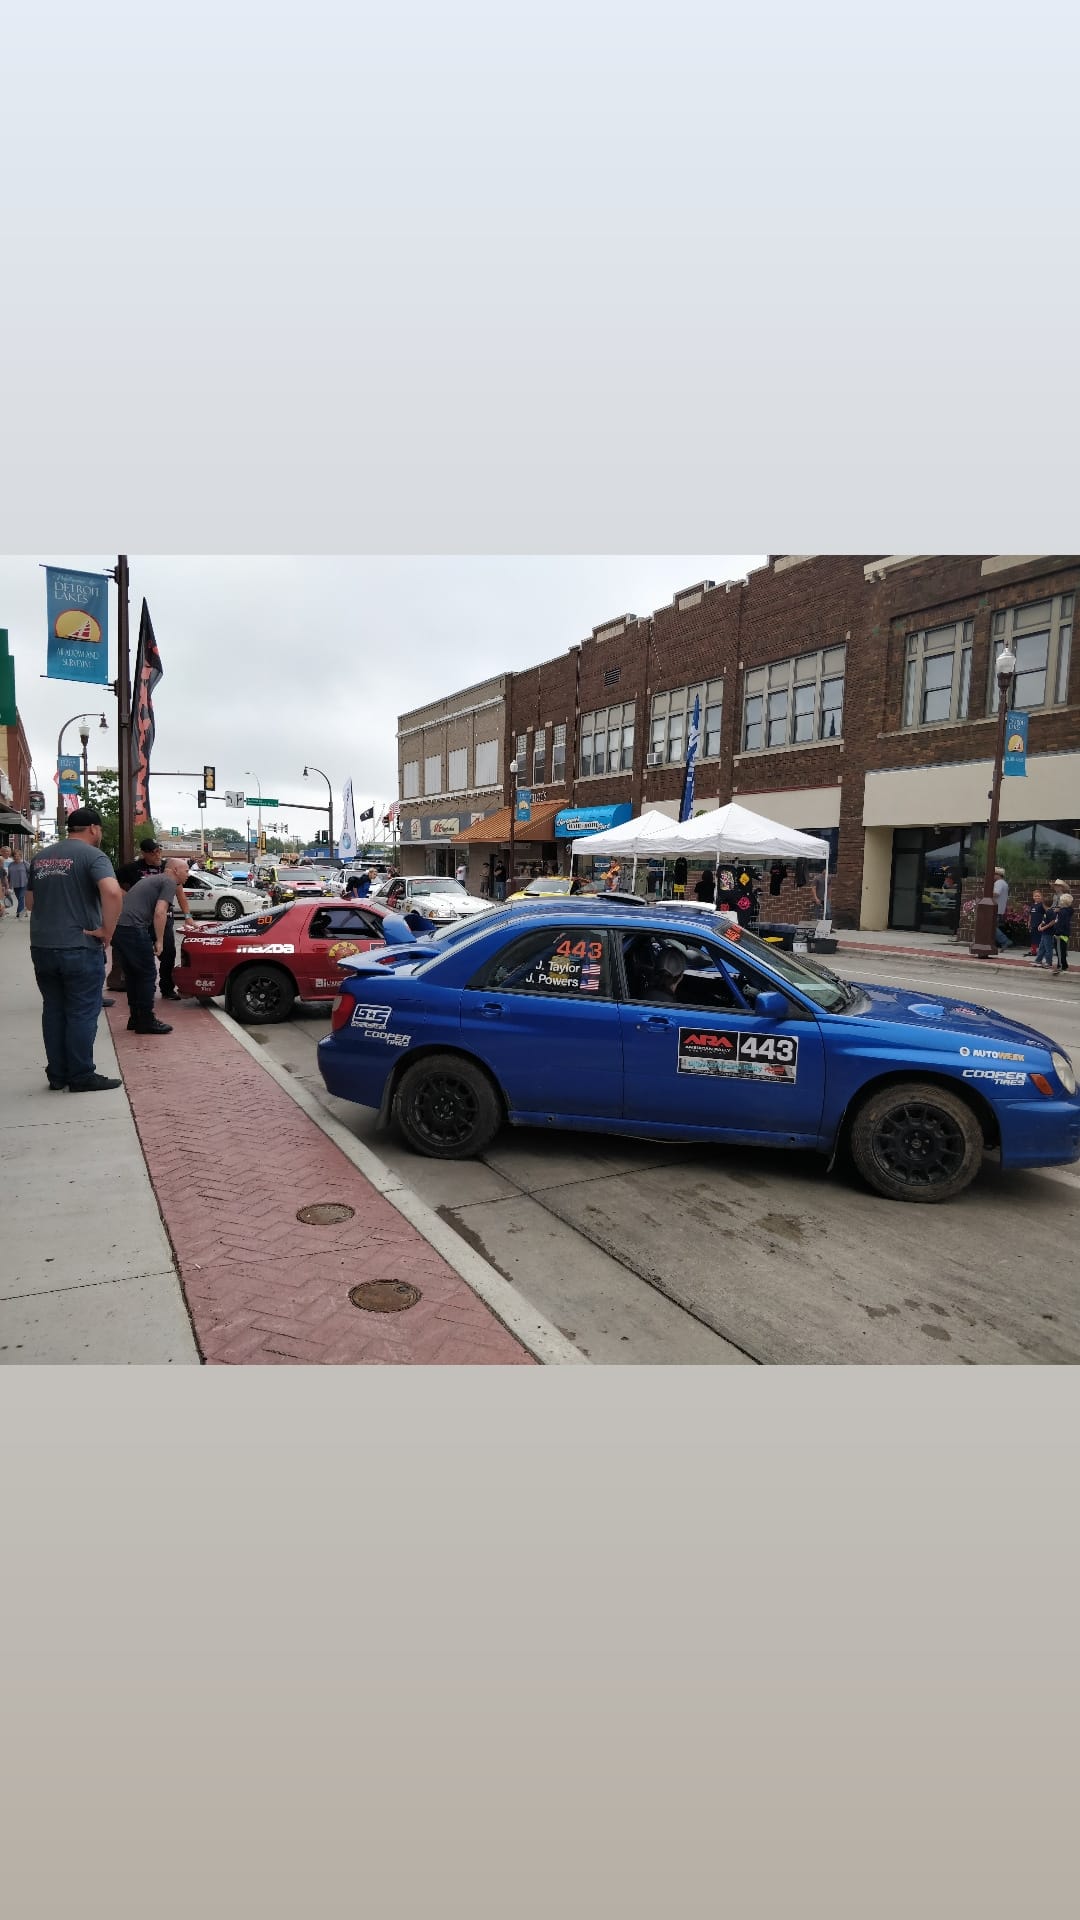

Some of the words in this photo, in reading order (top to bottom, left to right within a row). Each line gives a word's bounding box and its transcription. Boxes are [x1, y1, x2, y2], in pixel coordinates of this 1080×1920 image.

[54, 581, 99, 597] DETROIT
[54, 590, 89, 603] LAKES
[257, 915, 273, 925] 50
[556, 940, 603, 960] 443
[535, 960, 545, 971] J.
[548, 961, 581, 975] Taylor
[525, 972, 535, 983] J.
[538, 973, 579, 987] Powers
[364, 1030, 411, 1042] COOPER
[683, 1034, 734, 1048] ARA
[740, 1036, 794, 1062] 443
[962, 1069, 1026, 1080] COOPER
[993, 1078, 1025, 1086] TIRES
